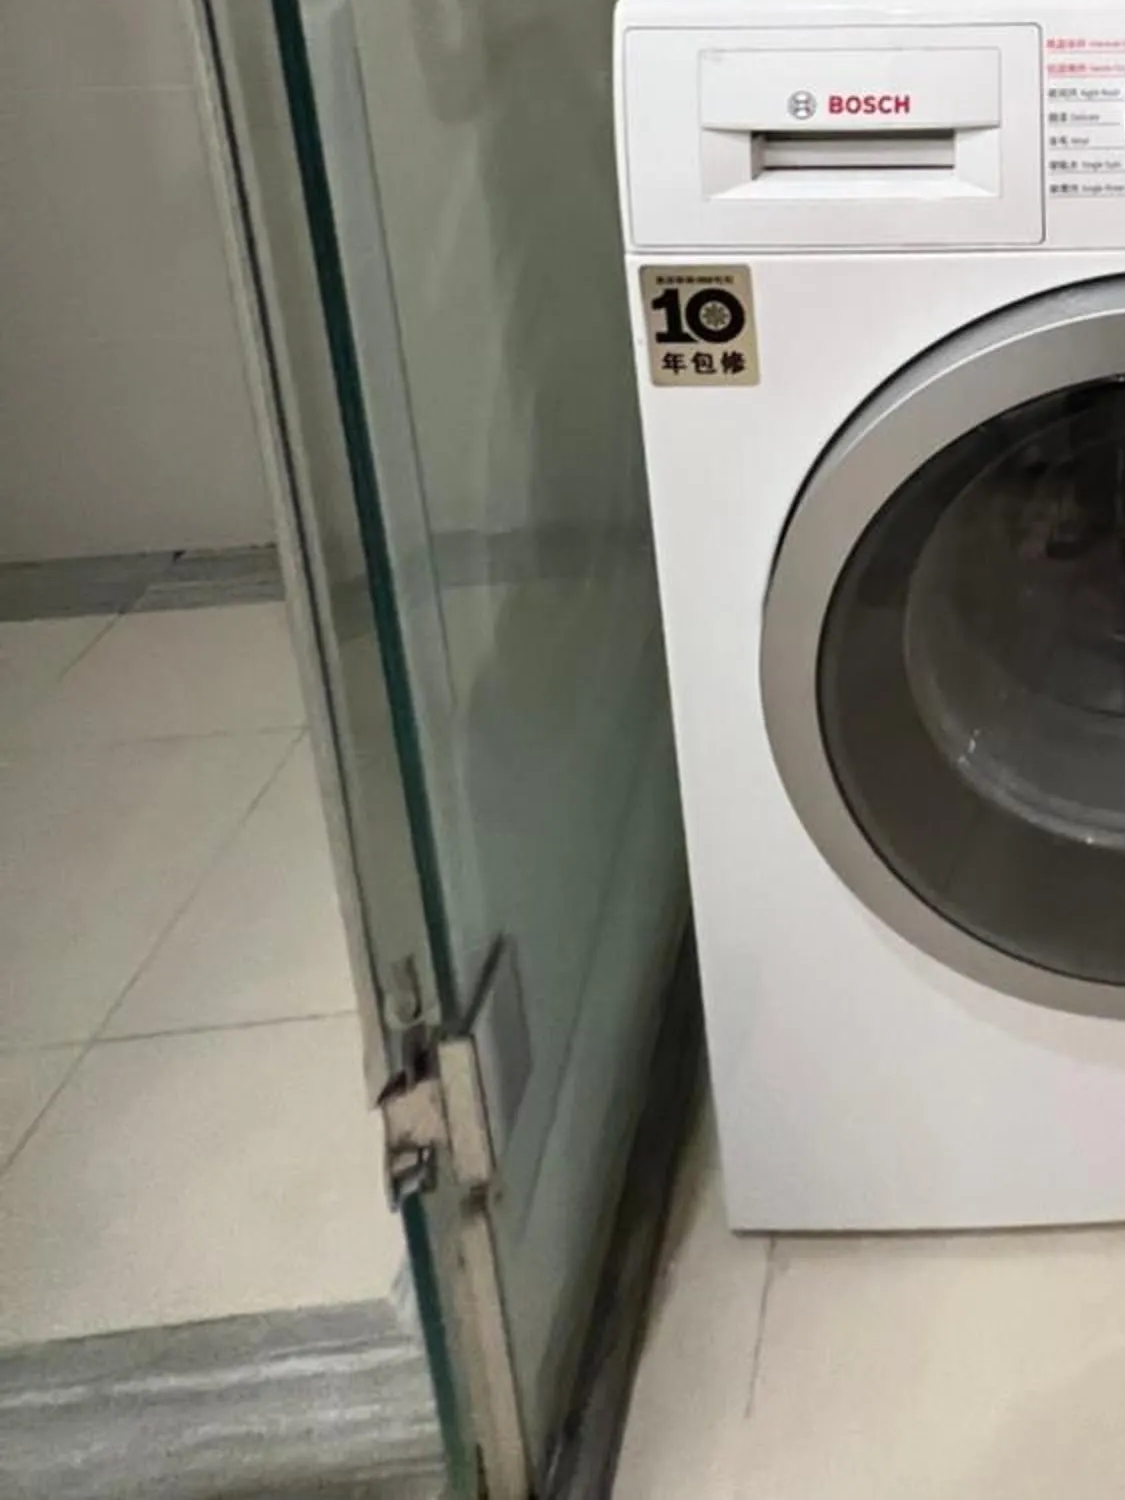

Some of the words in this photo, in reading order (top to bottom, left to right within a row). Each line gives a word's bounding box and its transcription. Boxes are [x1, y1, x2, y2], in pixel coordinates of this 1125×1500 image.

[828, 94, 911, 115] BOSCH
[652, 287, 746, 345] 10
[662, 350, 745, 376] 年包修
